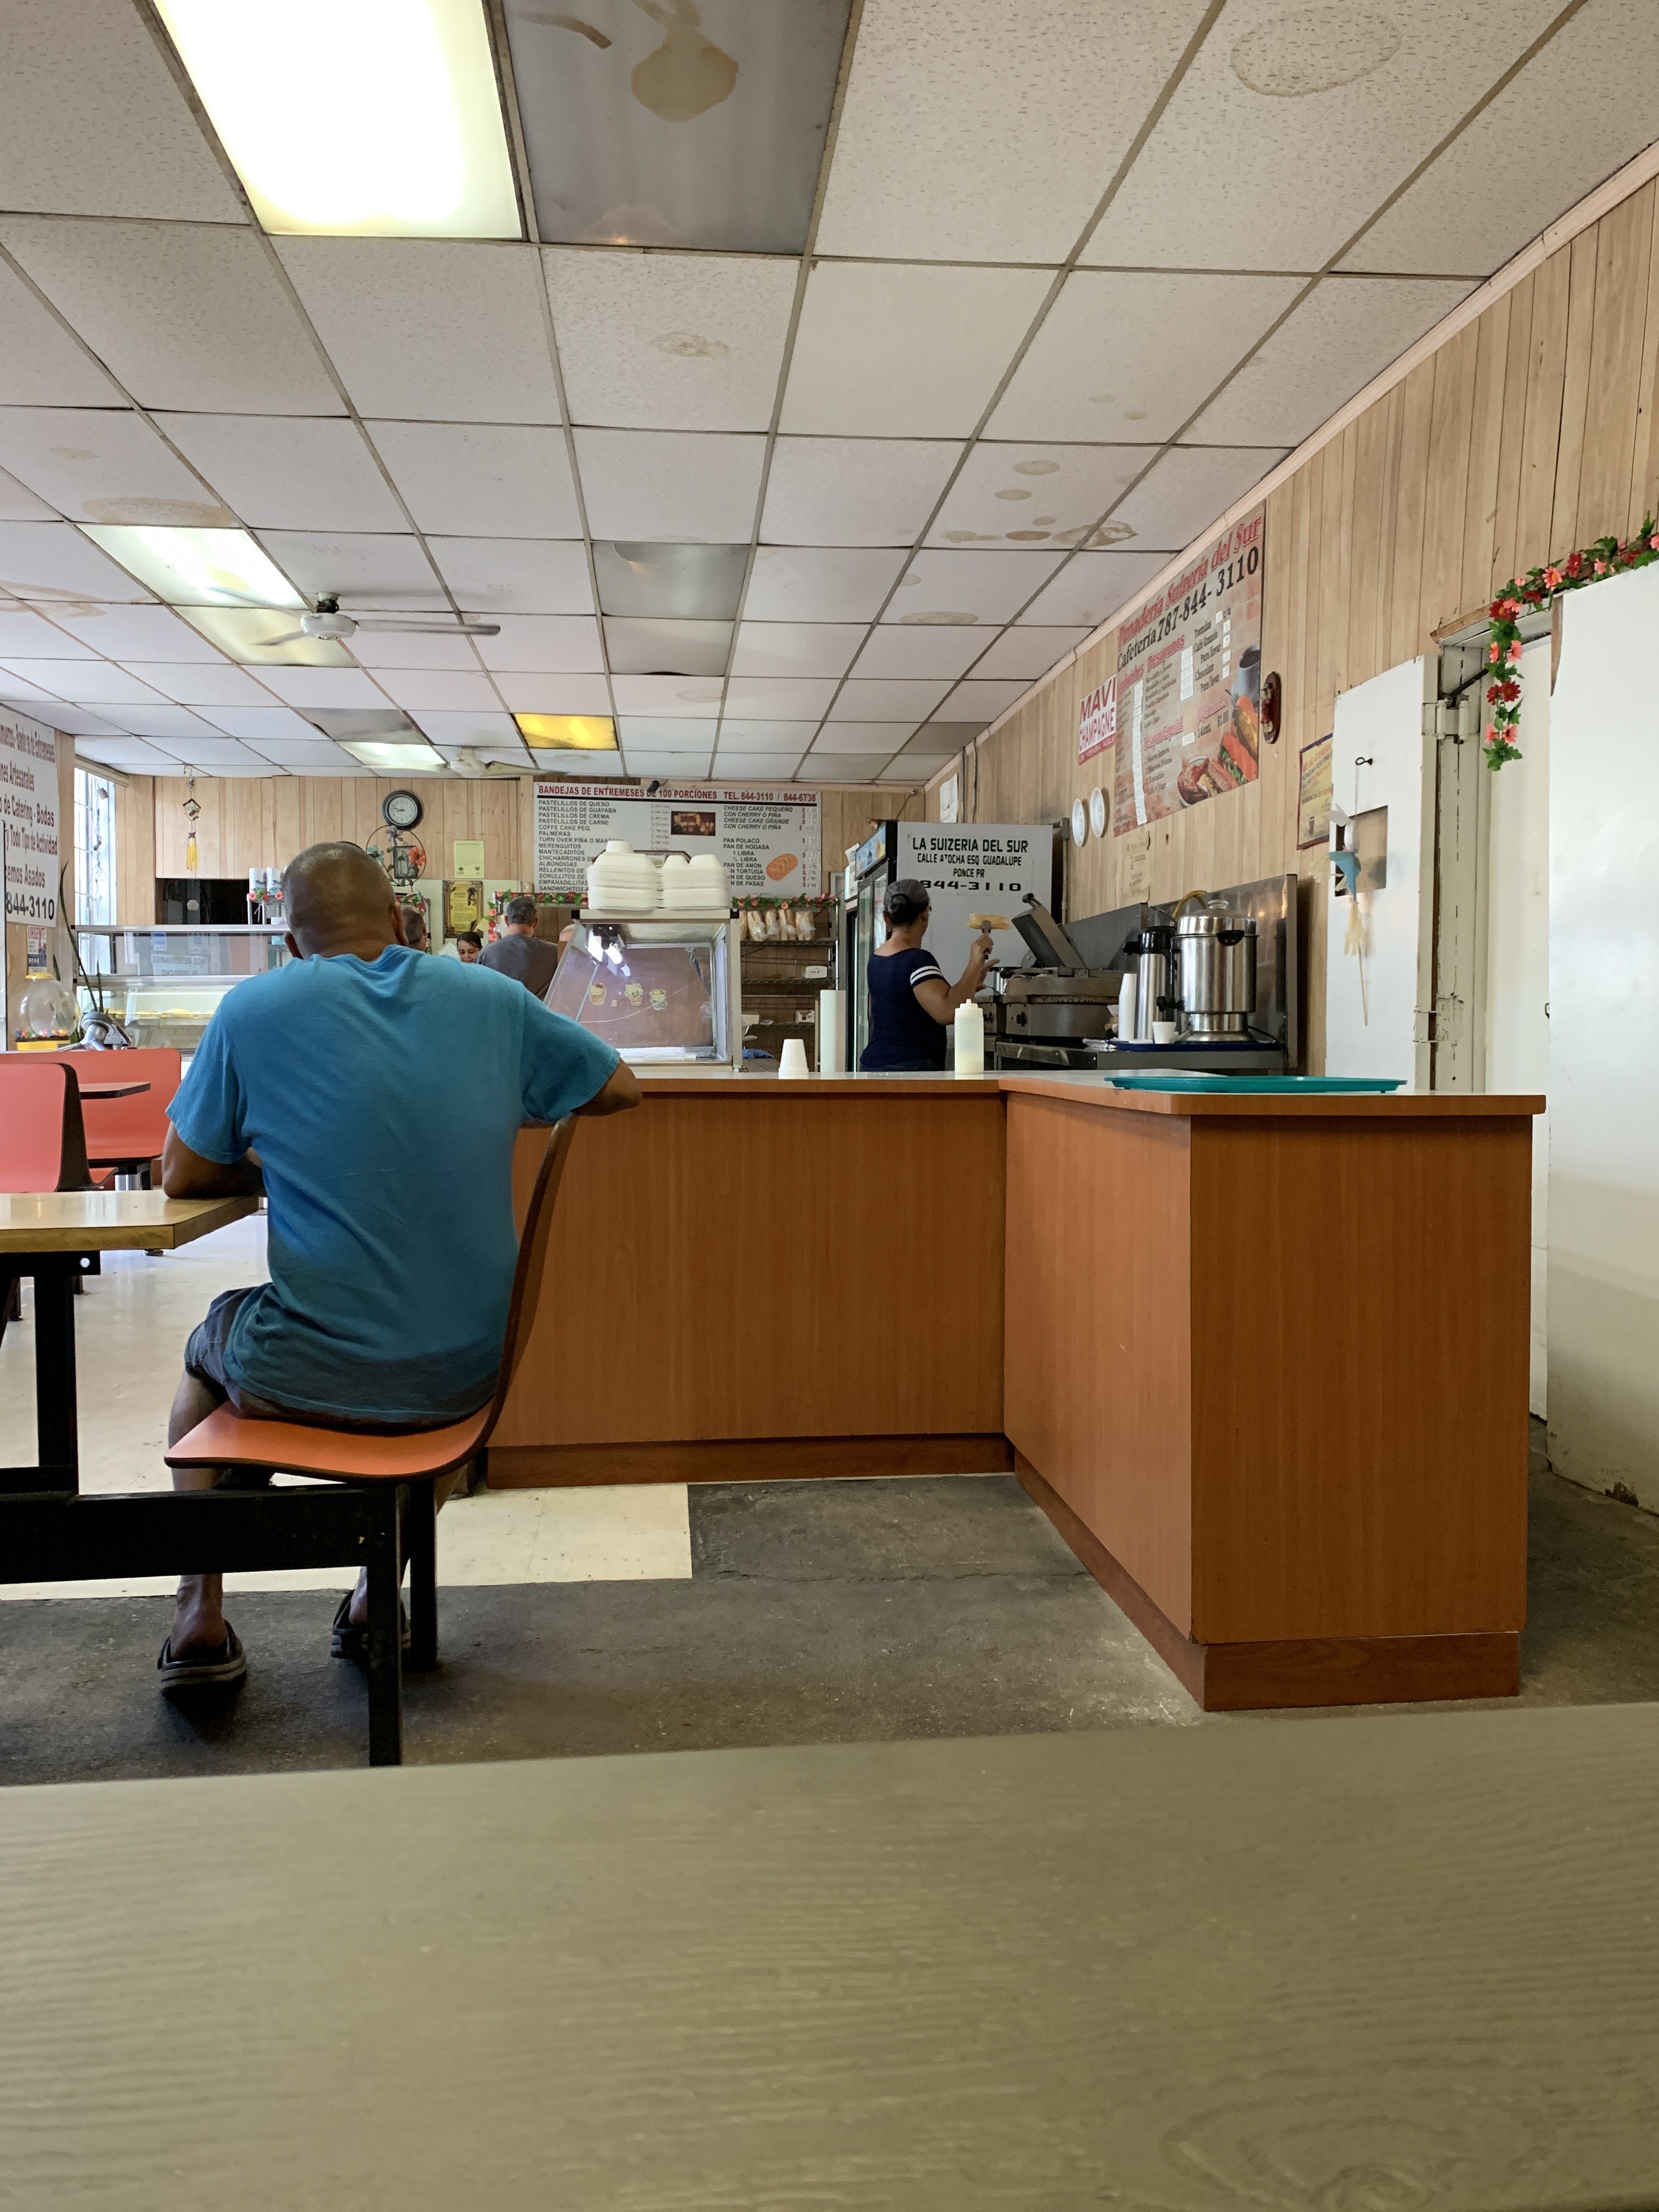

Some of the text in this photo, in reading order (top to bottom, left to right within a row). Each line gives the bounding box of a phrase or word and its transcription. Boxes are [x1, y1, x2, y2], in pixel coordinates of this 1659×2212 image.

[1211, 532, 1233, 571] del
[1233, 516, 1261, 552] Sur
[1118, 627, 1156, 671] Cafetería
[1216, 546, 1259, 596] 3110
[1080, 677, 1116, 722] MAVI
[9, 760, 35, 791] Artesanales
[539, 786, 579, 795] BANDEJAS
[582, 787, 591, 795] DE
[594, 787, 644, 797] ENTREMESES
[674, 790, 717, 799] PORCIONES
[724, 792, 739, 800] TEL.
[741, 792, 773, 800] 844-3110
[784, 793, 816, 802] 844-6738
[4, 793, 10, 815] de
[12, 794, 32, 827] Catering
[37, 803, 54, 827] Bodas
[10, 824, 20, 848] Todo
[31, 830, 35, 851] de
[36, 831, 58, 856] Actividad
[913, 838, 1028, 853] LA SUIZERIA DEL SUR
[917, 853, 1022, 866] CALLE ATOCHA ESQ GUADALUPE
[953, 868, 985, 878] PONCE PR
[24, 863, 45, 888] Asados
[6, 891, 54, 919] 844-3110
